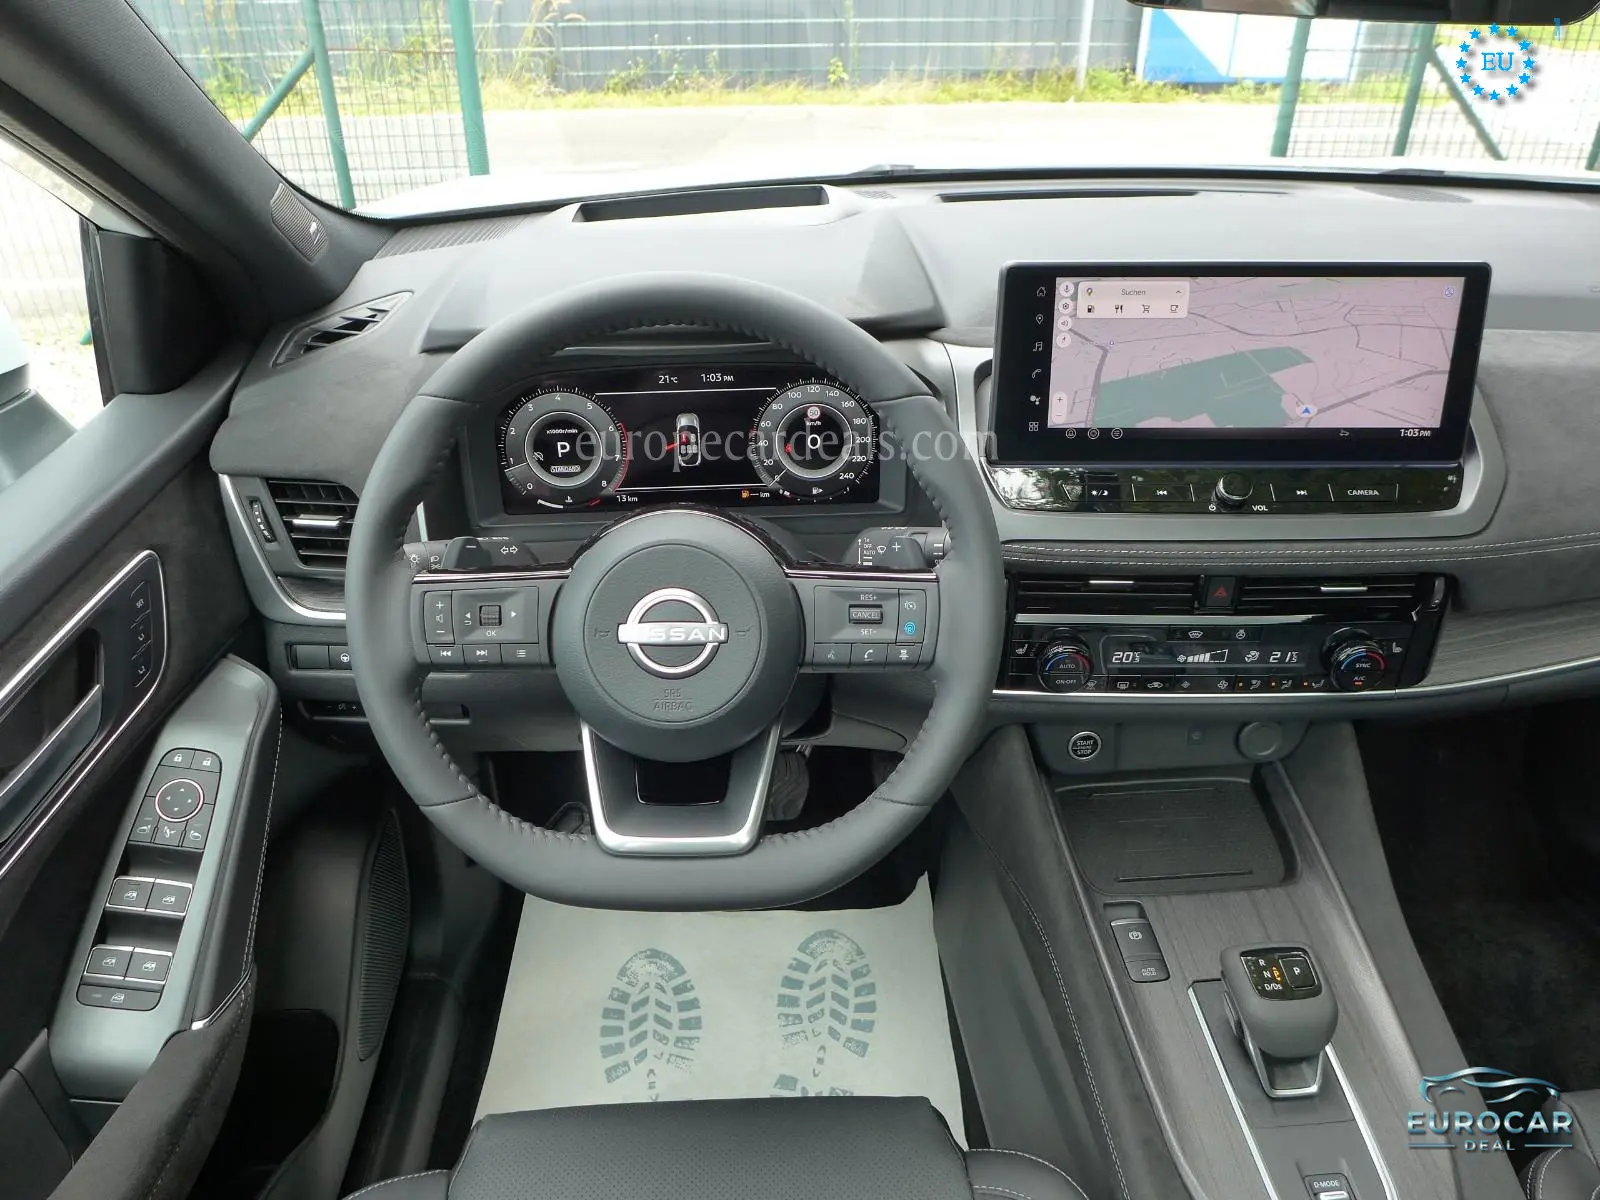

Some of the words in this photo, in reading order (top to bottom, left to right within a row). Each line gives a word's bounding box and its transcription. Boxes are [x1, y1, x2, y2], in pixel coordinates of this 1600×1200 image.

[701, 373, 722, 382] 1:03
[1400, 429, 1419, 437] 1:03
[557, 441, 570, 458] P
[1293, 967, 1300, 975] P
